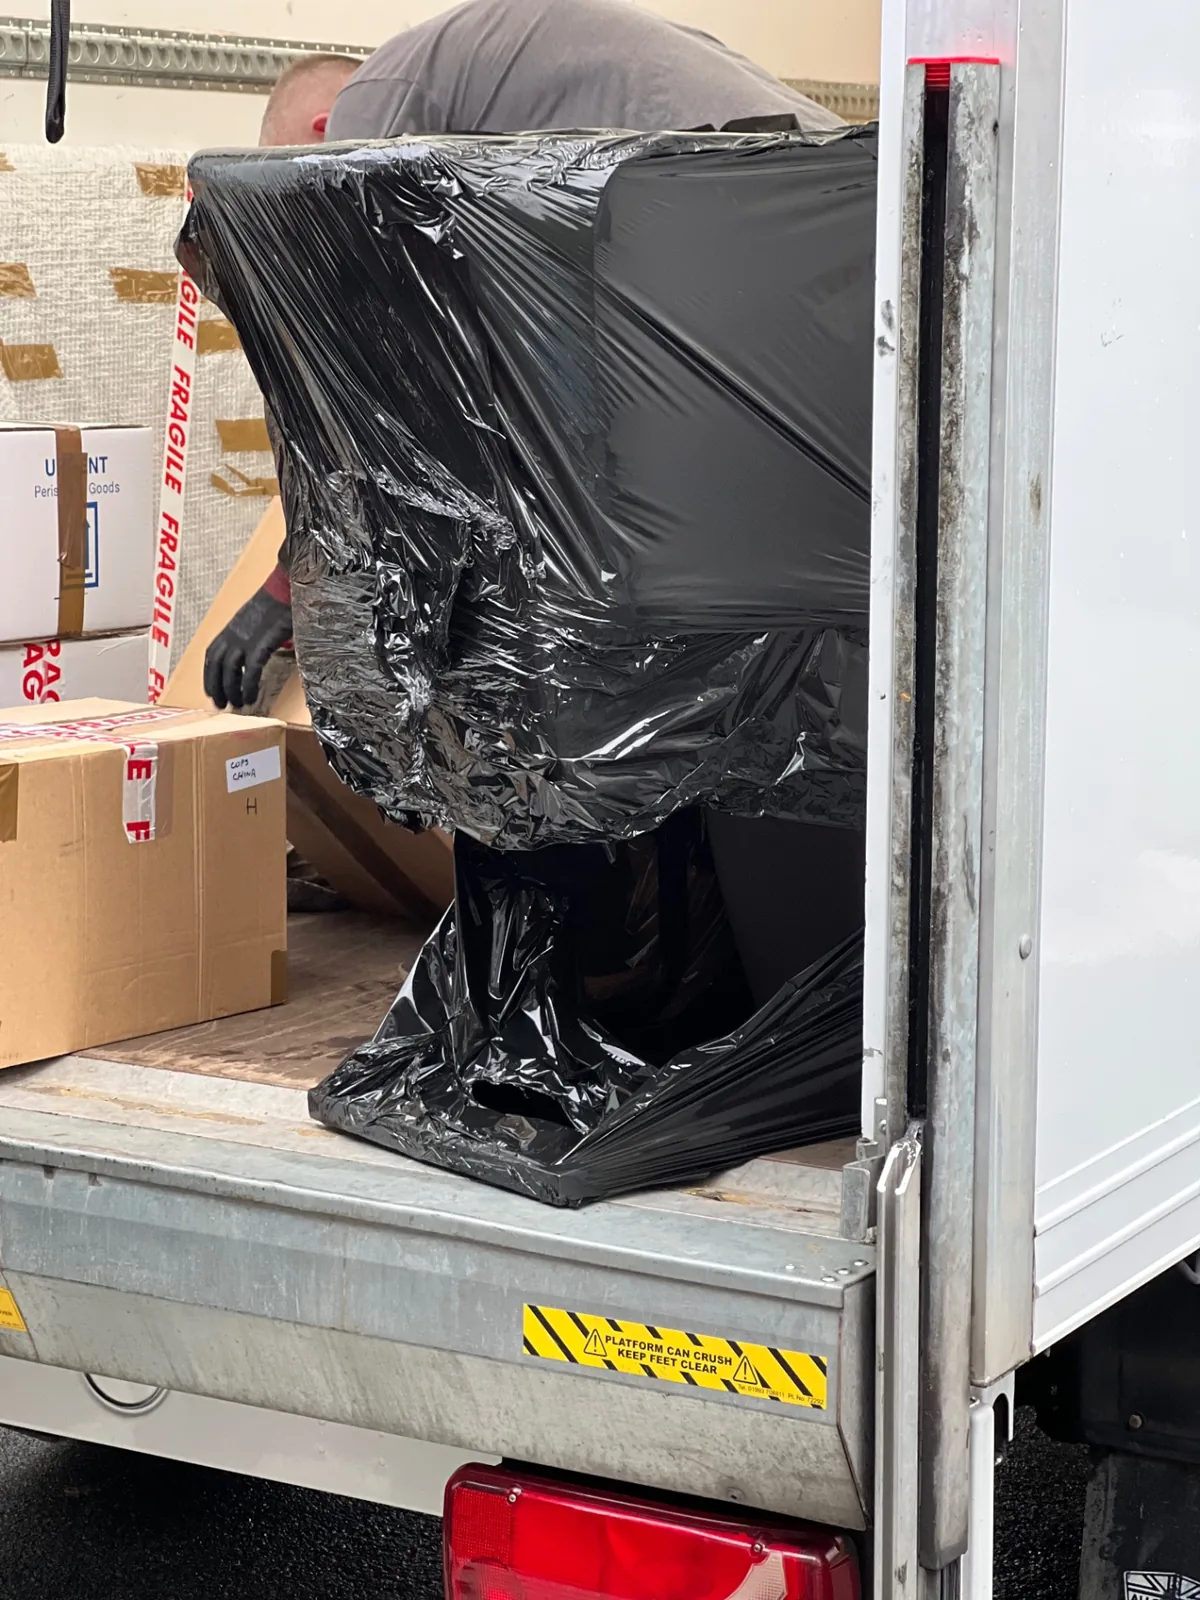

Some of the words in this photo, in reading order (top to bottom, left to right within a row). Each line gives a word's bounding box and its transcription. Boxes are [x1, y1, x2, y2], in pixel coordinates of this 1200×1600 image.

[177, 271, 198, 350] GILE
[165, 365, 191, 495] FRAGILE
[45, 456, 108, 476] UNT
[88, 481, 120, 495] Goods
[152, 511, 179, 648] FRAGILE
[232, 768, 257, 781] CHINA
[246, 797, 257, 815] H
[605, 1335, 663, 1354] PLATFORM
[666, 1346, 690, 1359] CAN
[693, 1351, 732, 1366] CRUSH
[617, 1348, 646, 1362] KEEP
[649, 1354, 677, 1367] FEET
[680, 1360, 717, 1375] CLEAR
